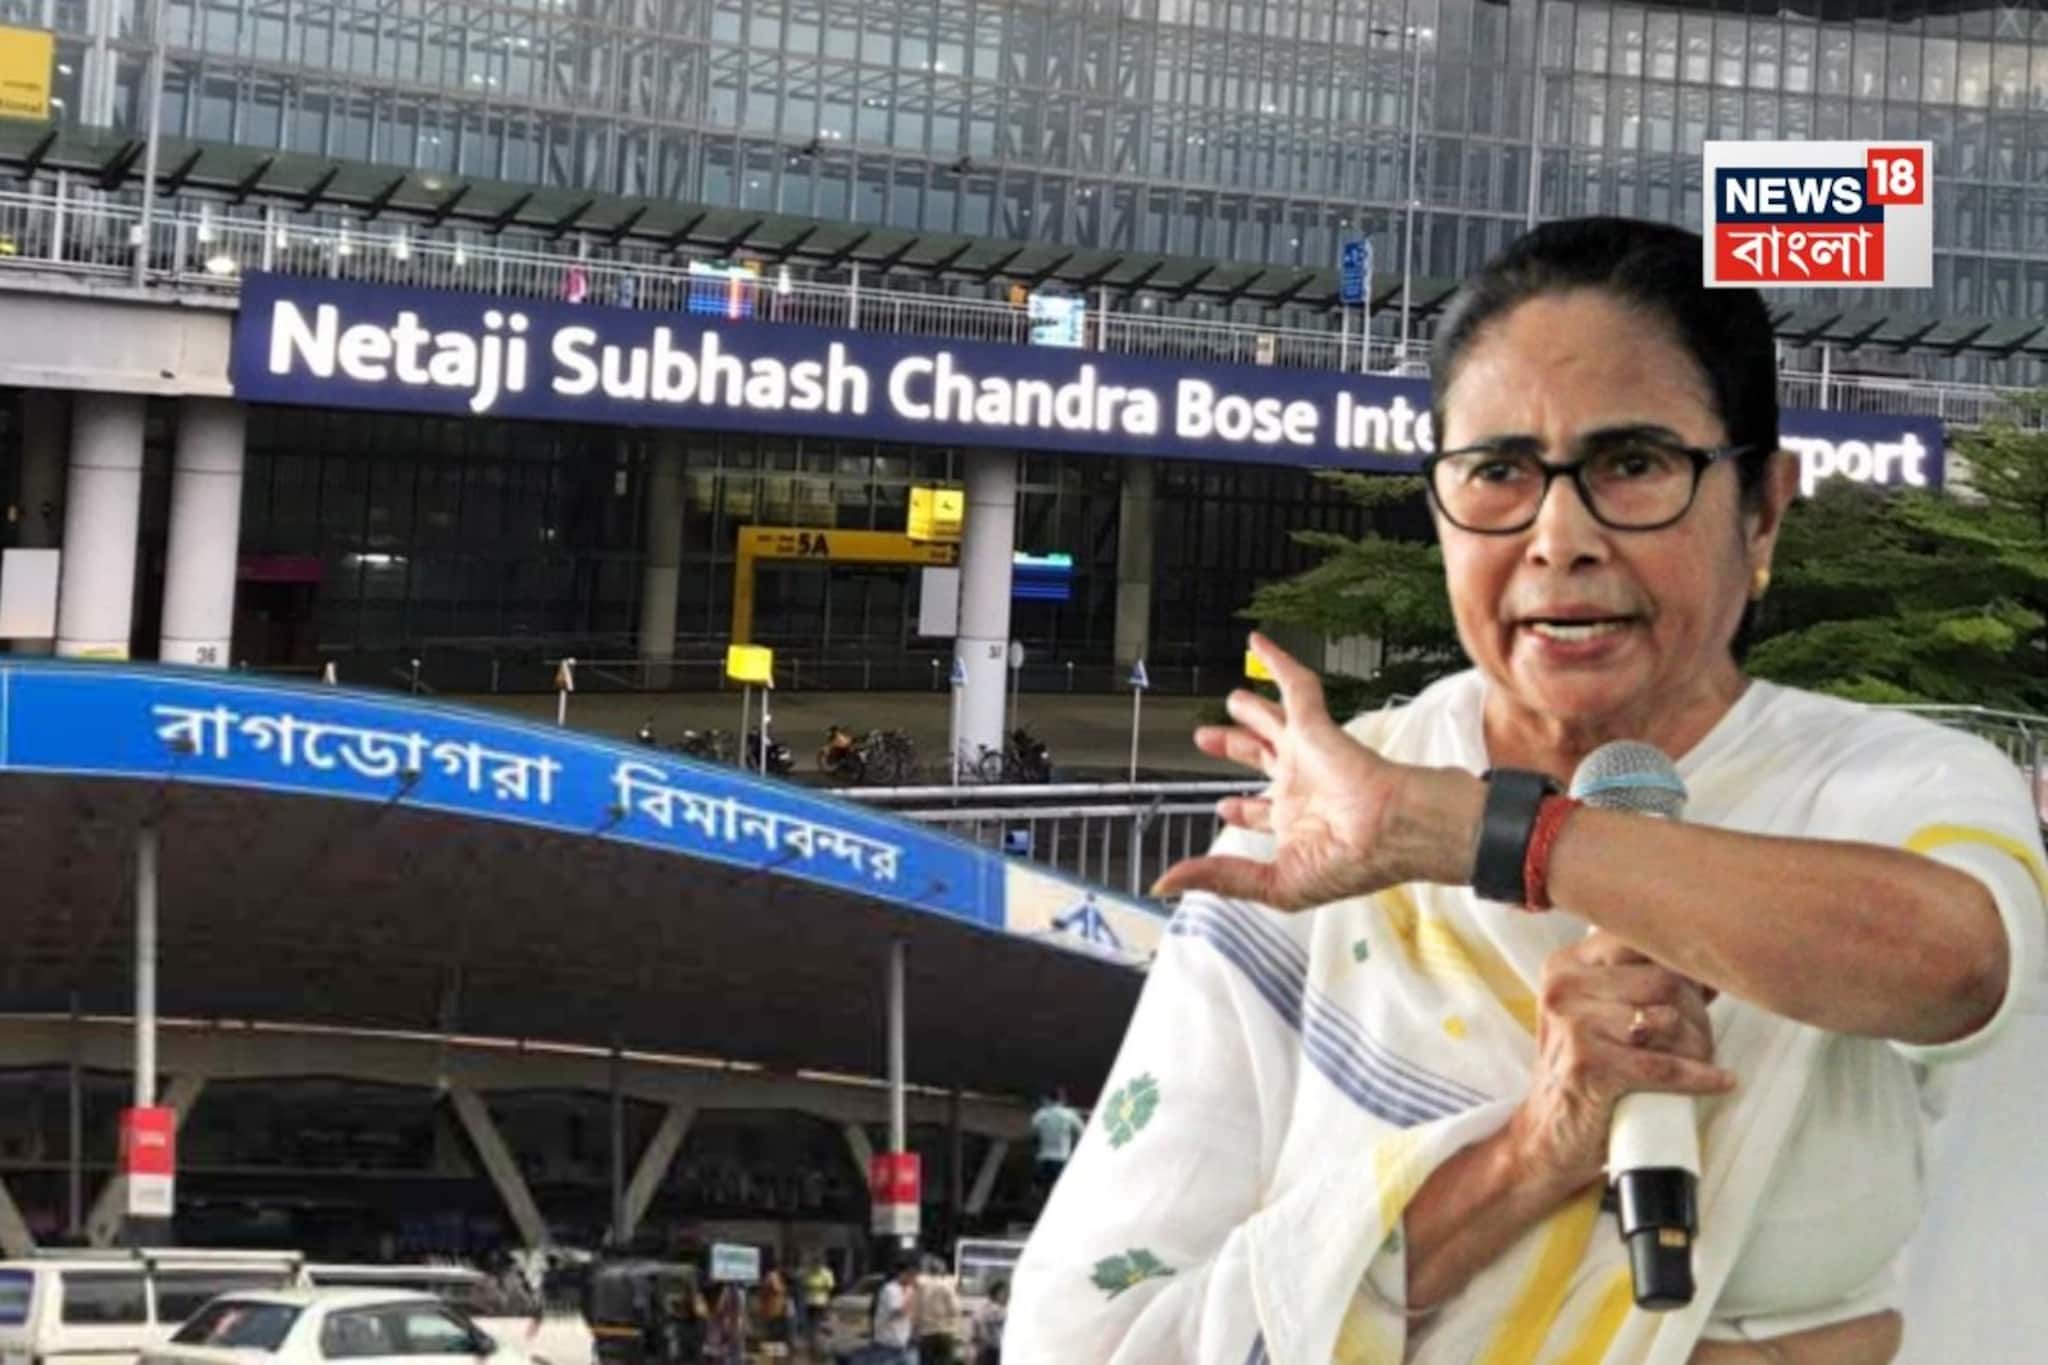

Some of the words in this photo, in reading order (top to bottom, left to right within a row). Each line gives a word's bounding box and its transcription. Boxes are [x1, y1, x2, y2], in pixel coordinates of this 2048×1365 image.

[268, 299, 530, 414] Netaji
[550, 318, 871, 416] Subhash
[886, 351, 1161, 435] Chandra
[1174, 377, 1320, 446] Bose
[1334, 390, 1436, 454] Inte
[1778, 432, 1927, 498] port
[797, 534, 830, 556] 5A
[151, 703, 563, 806] বাগডোগরা
[610, 760, 903, 882] বিমানবন্দর
